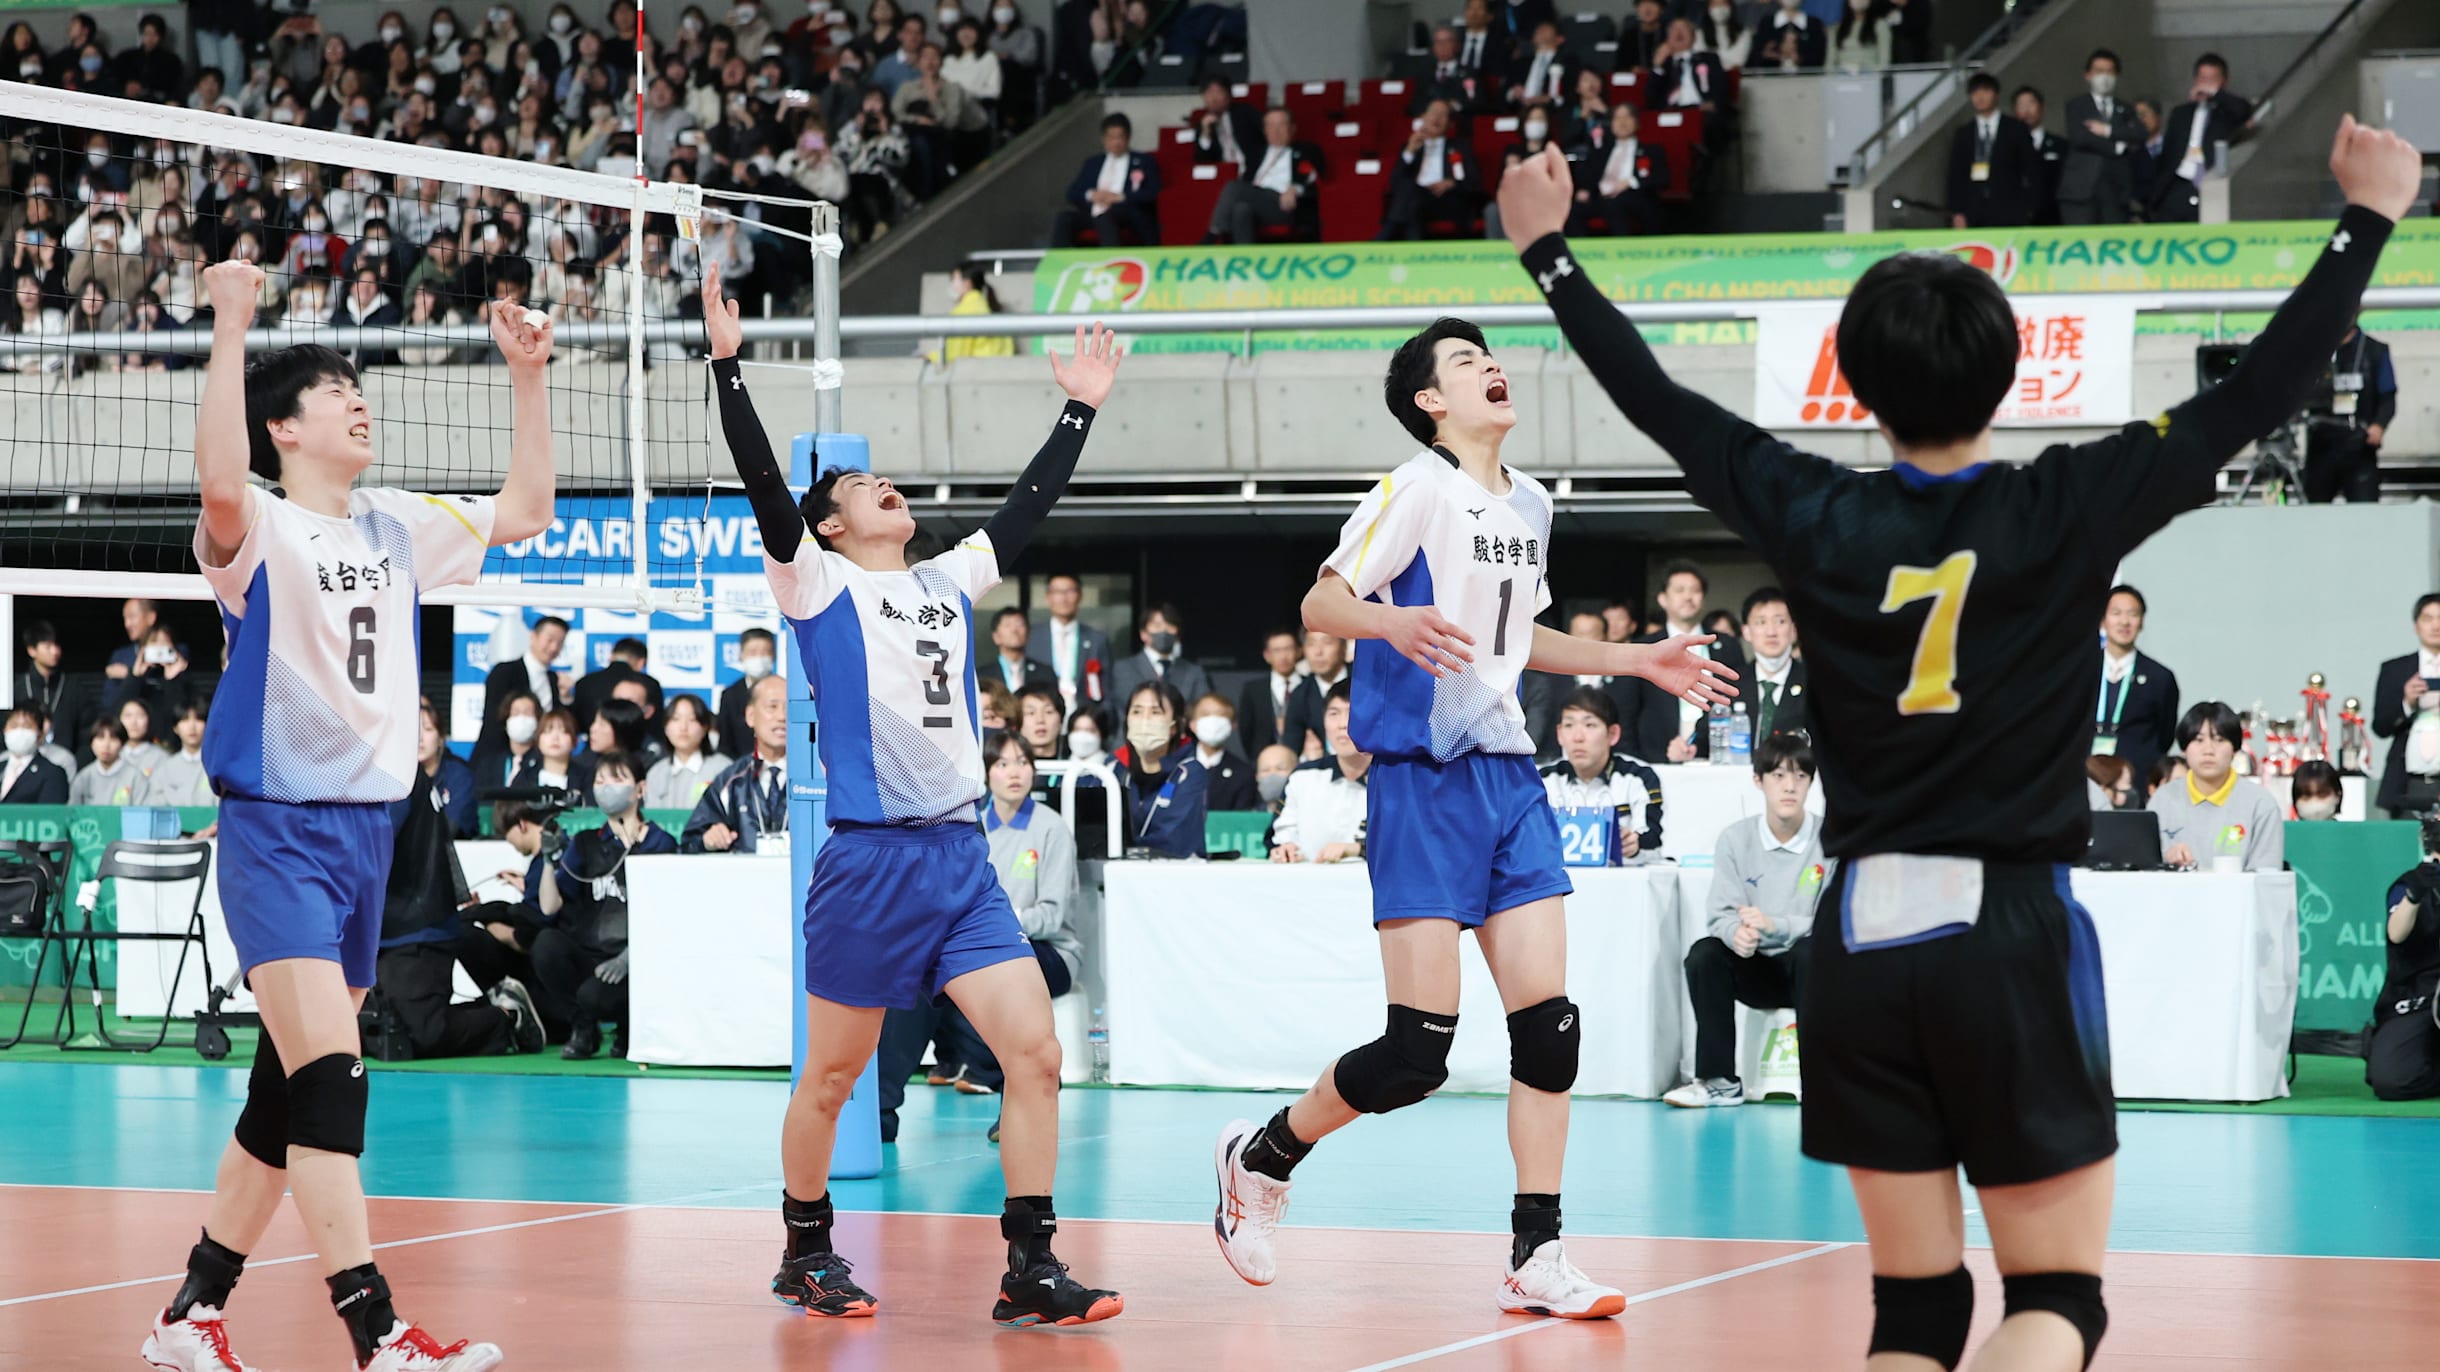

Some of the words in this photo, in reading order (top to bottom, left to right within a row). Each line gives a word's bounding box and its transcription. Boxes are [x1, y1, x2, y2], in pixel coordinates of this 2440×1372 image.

[1155, 253, 1356, 282] HARUKO
[2024, 237, 2238, 265] HARUKO
[1290, 286, 1358, 307] HIGH
[1366, 285, 1476, 305] SCHOOL
[1663, 278, 1854, 300] CHAMPIONS
[2170, 272, 2242, 290] HIGH
[1473, 534, 1538, 567] 駿台学園
[1494, 578, 1513, 656] 1
[1878, 549, 1977, 716] 7
[347, 606, 376, 694] 6
[916, 639, 951, 705] 3
[1560, 822, 1605, 862] 24
[2336, 922, 2387, 946] ALL
